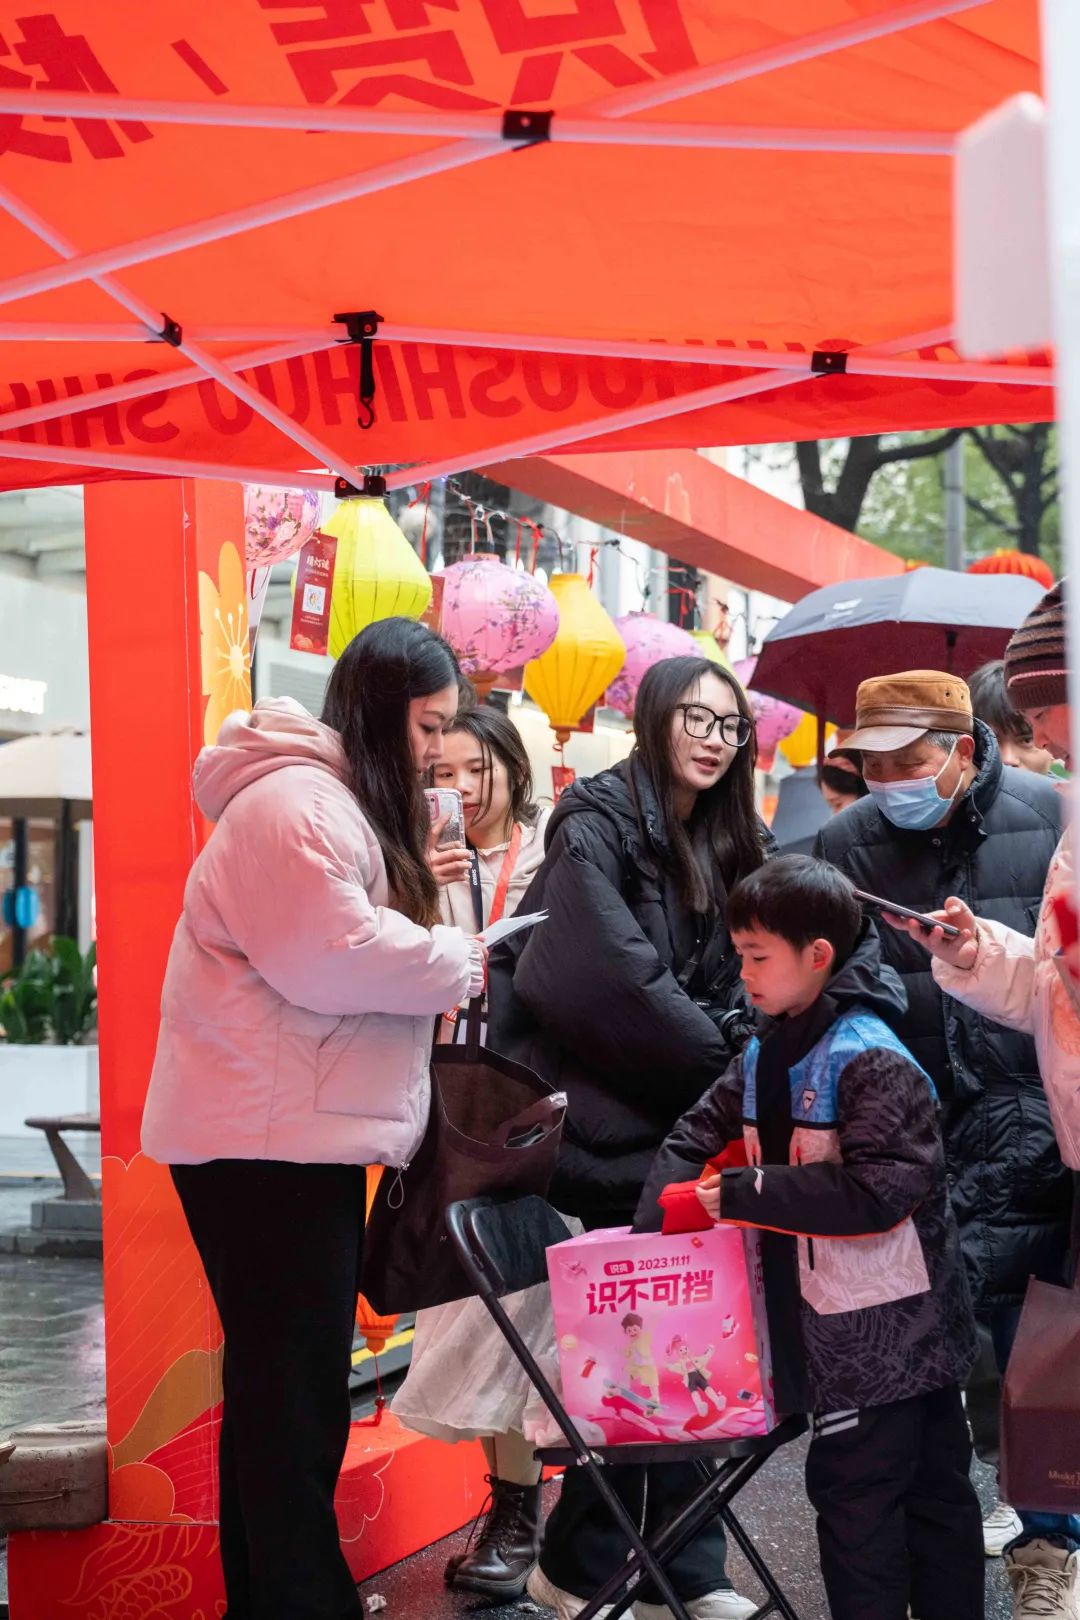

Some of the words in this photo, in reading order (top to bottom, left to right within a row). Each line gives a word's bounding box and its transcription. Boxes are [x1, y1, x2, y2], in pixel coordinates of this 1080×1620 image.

[638, 1255, 690, 1271] 2023.11.11
[586, 1269, 714, 1315] 识不可挡
